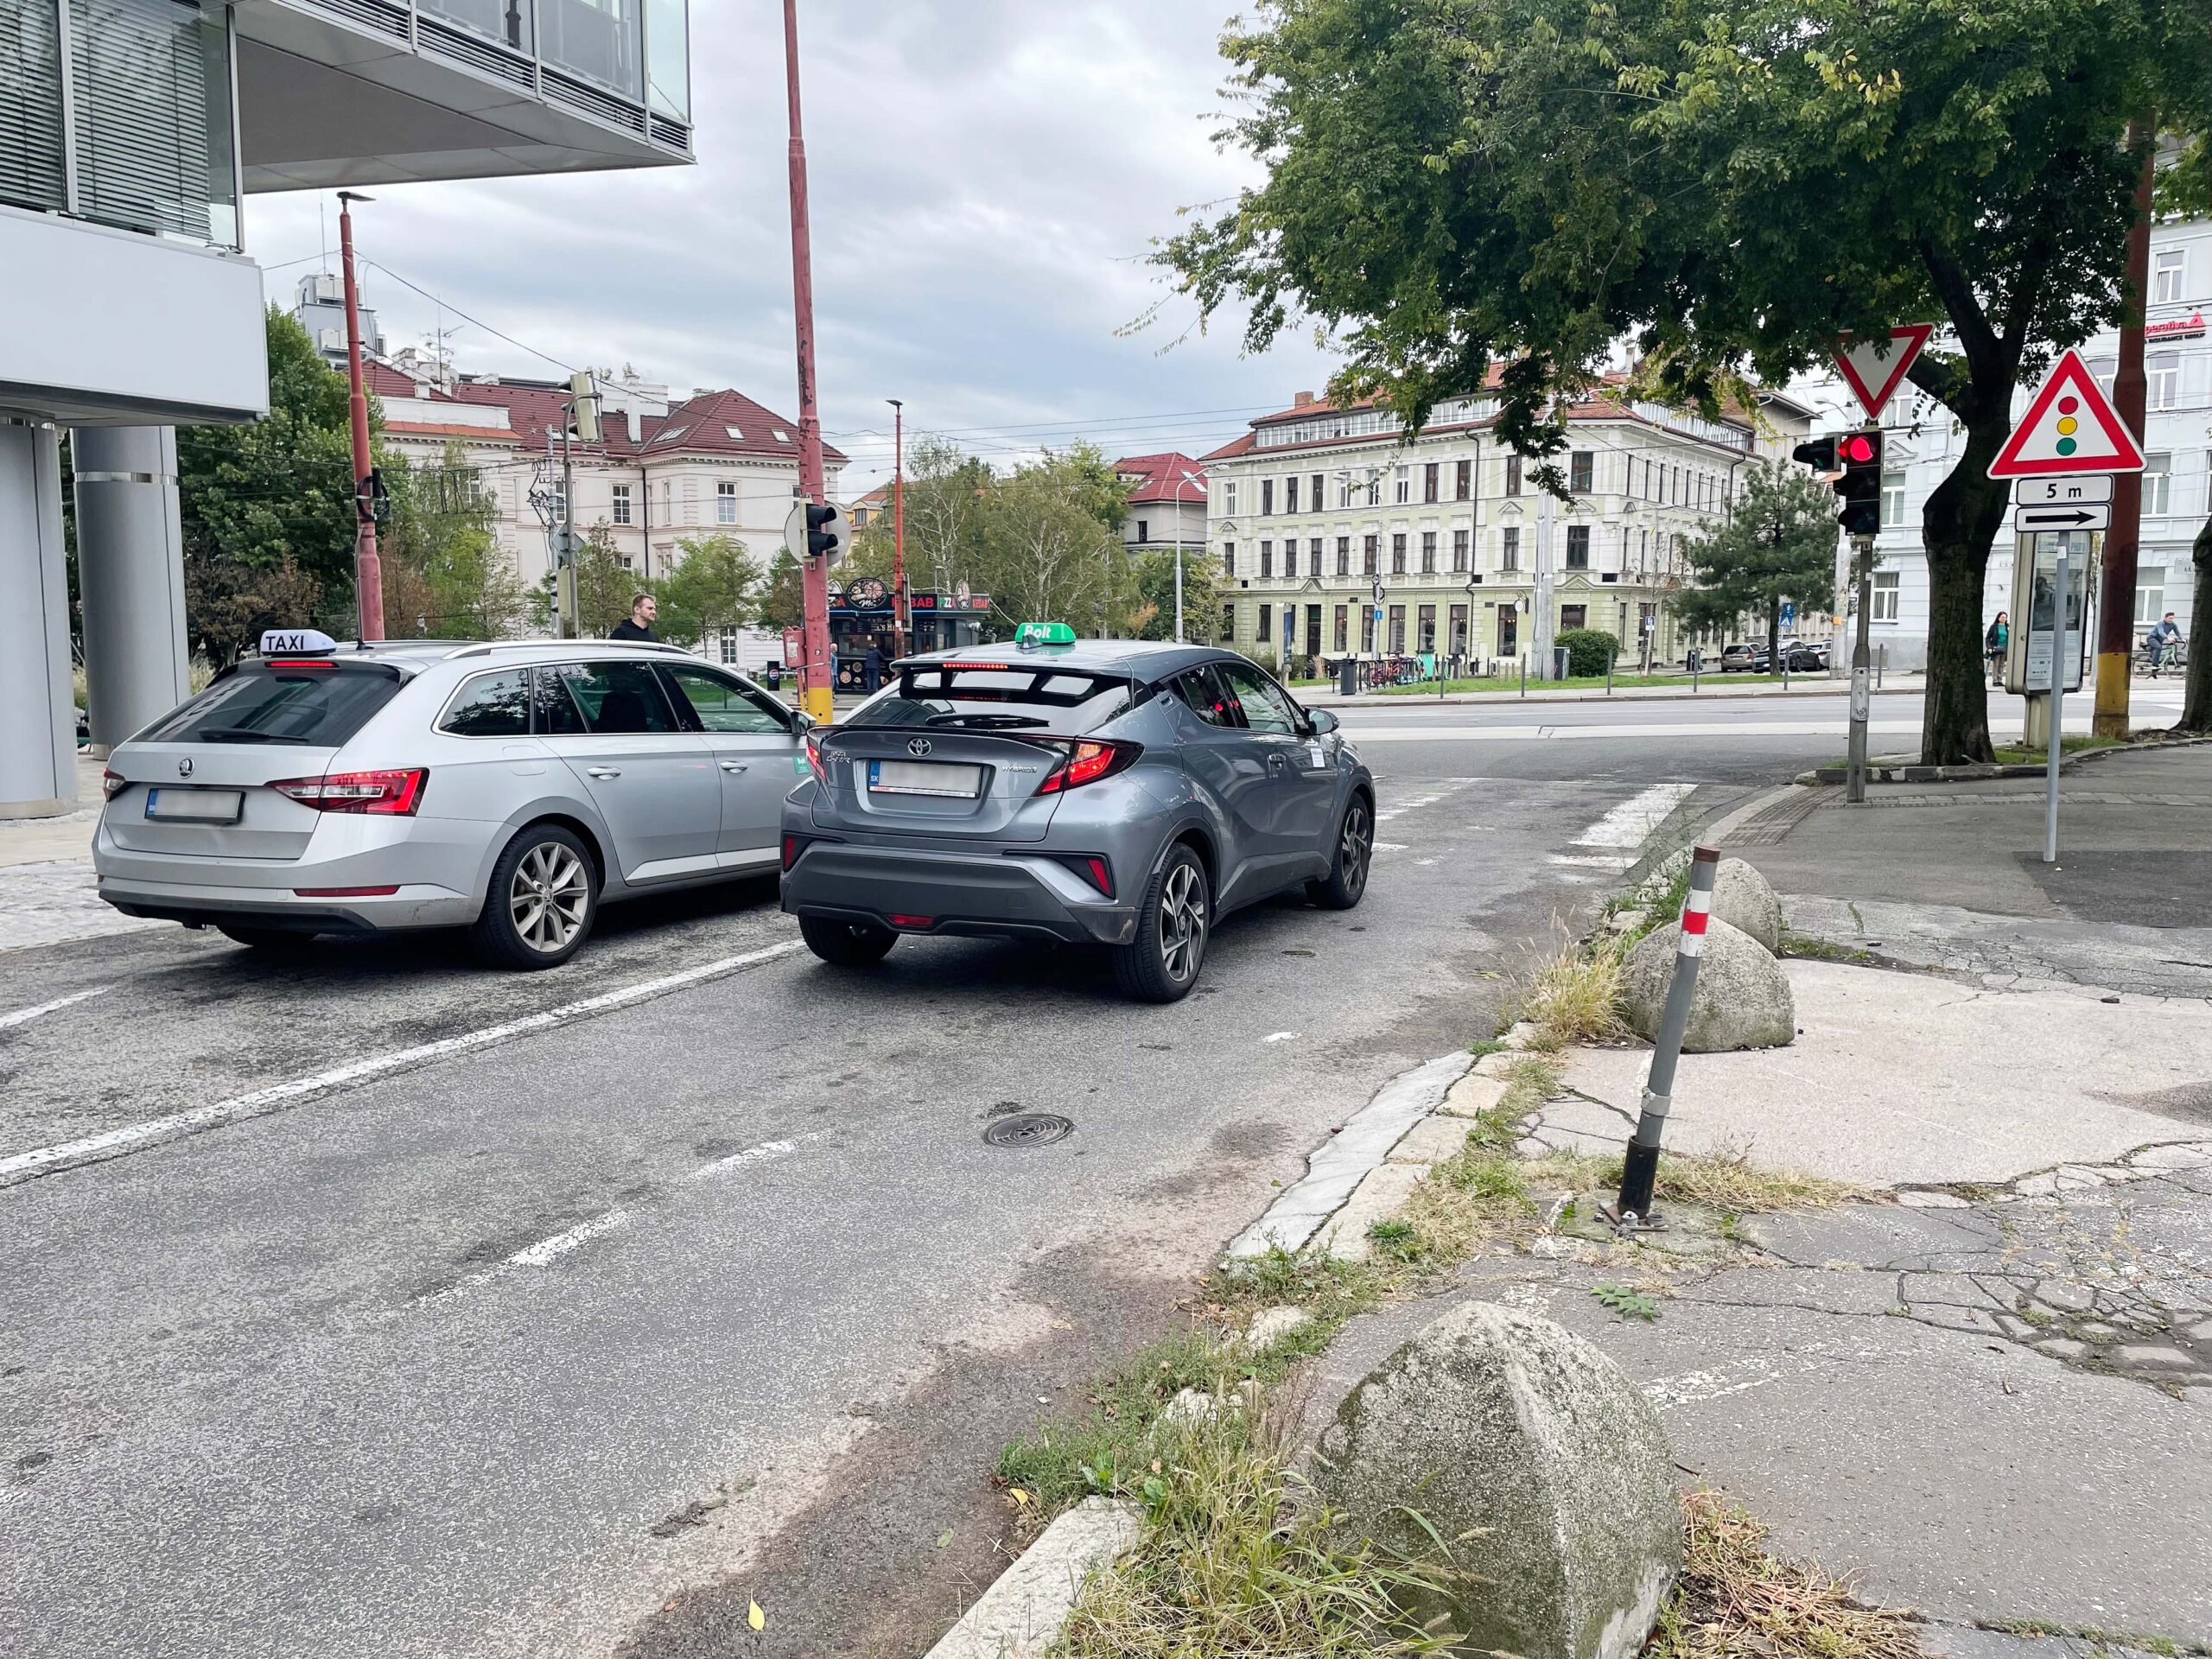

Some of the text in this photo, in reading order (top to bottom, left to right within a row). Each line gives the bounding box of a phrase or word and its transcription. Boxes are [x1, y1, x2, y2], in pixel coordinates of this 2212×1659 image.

[2046, 483, 2082, 499] 5 m
[1025, 625, 1052, 639] Bolt
[265, 635, 304, 651] TAXI
